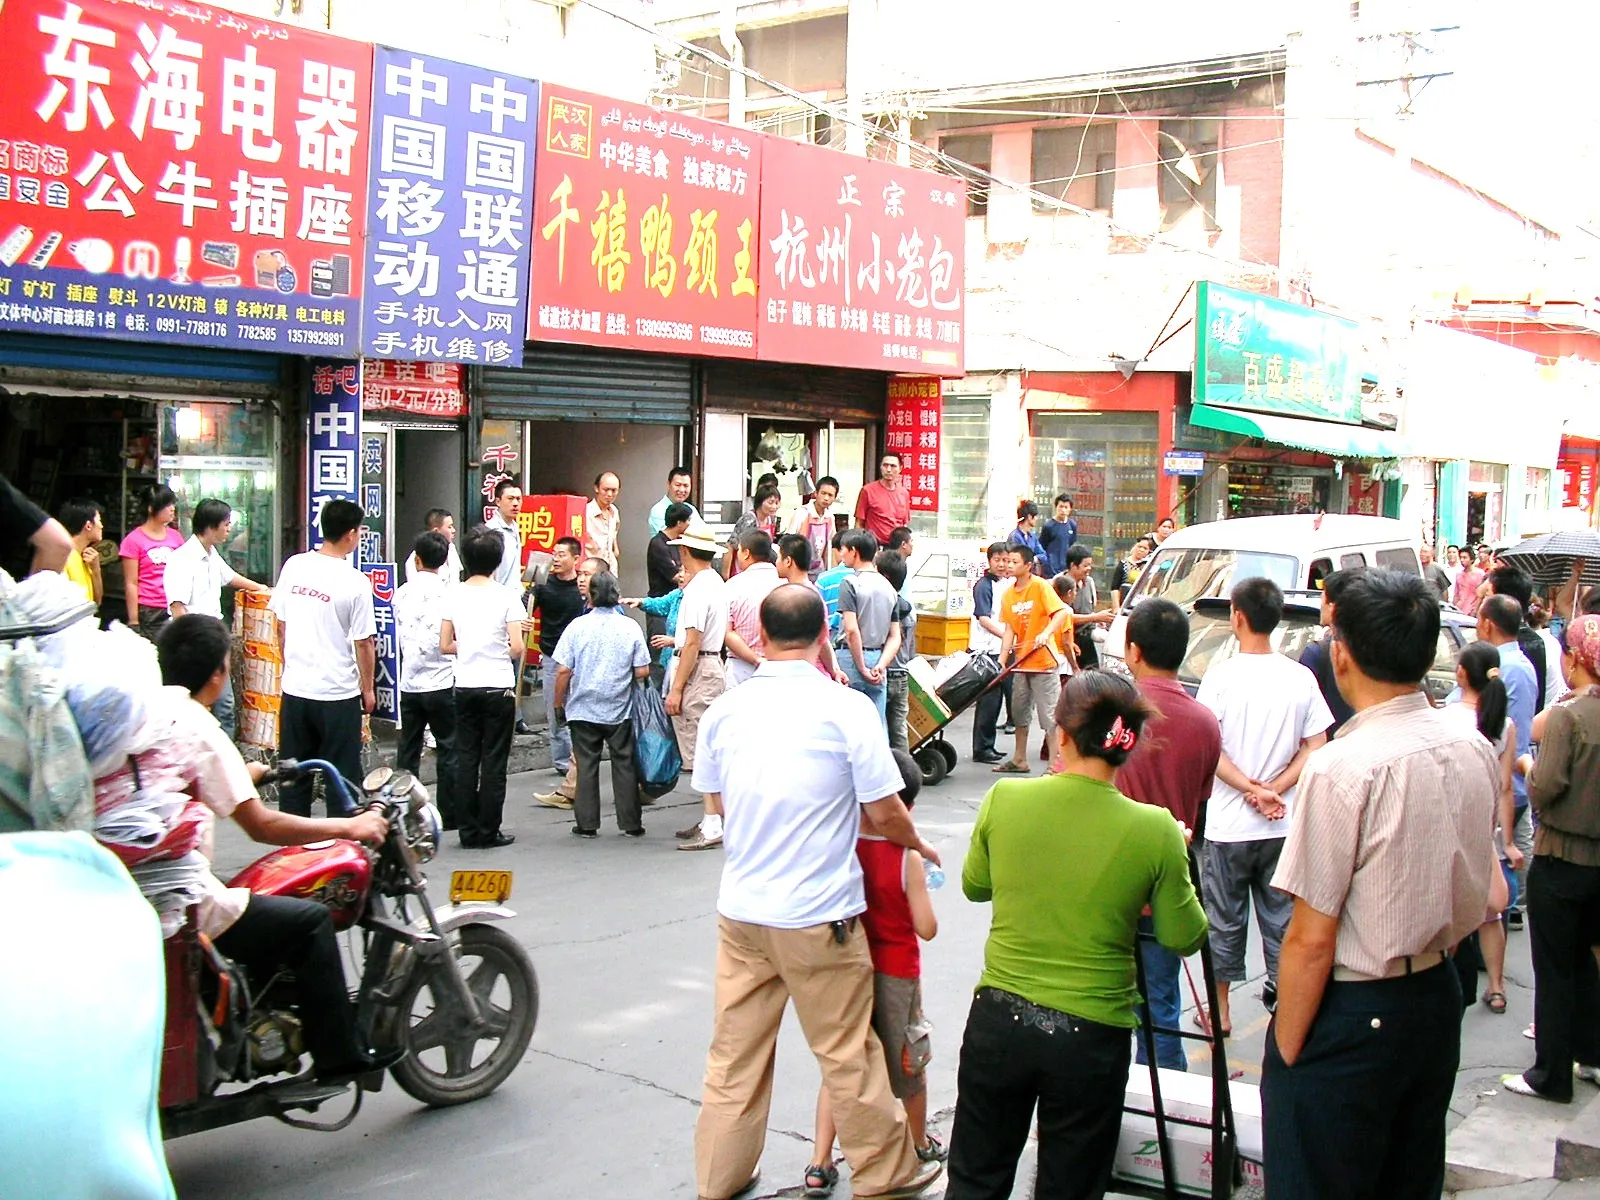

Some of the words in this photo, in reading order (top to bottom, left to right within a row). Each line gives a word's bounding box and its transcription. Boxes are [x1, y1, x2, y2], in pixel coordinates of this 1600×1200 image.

[36, 2, 358, 176] 东海电器
[552, 103, 587, 127] 武汉
[551, 130, 586, 152] 人家
[373, 57, 448, 297] 中国移动
[600, 138, 670, 180] 中华美食
[683, 155, 748, 196] 独家秘方
[74, 151, 353, 245] 公牛插座
[456, 77, 527, 306] 中国联通
[837, 174, 905, 217] 正宗
[769, 208, 960, 310] 杭州小笼包
[23, 280, 56, 299] 矿灯
[67, 283, 98, 304] 插座
[109, 287, 139, 307] 熨斗
[235, 300, 288, 321] 各种灯具
[296, 306, 346, 326] 电工电料
[373, 301, 512, 334] 手机入网
[767, 297, 788, 324] 包子
[238, 325, 278, 342] 7782585
[287, 329, 345, 346] 13579929891
[372, 331, 513, 362] 手机维修
[312, 365, 359, 395] 话吧
[888, 382, 938, 398] 杭州小笼包
[887, 409, 913, 426] 小笼包
[887, 431, 913, 447] 刀削面
[517, 505, 555, 549] 鸭
[454, 872, 508, 893] 44260
